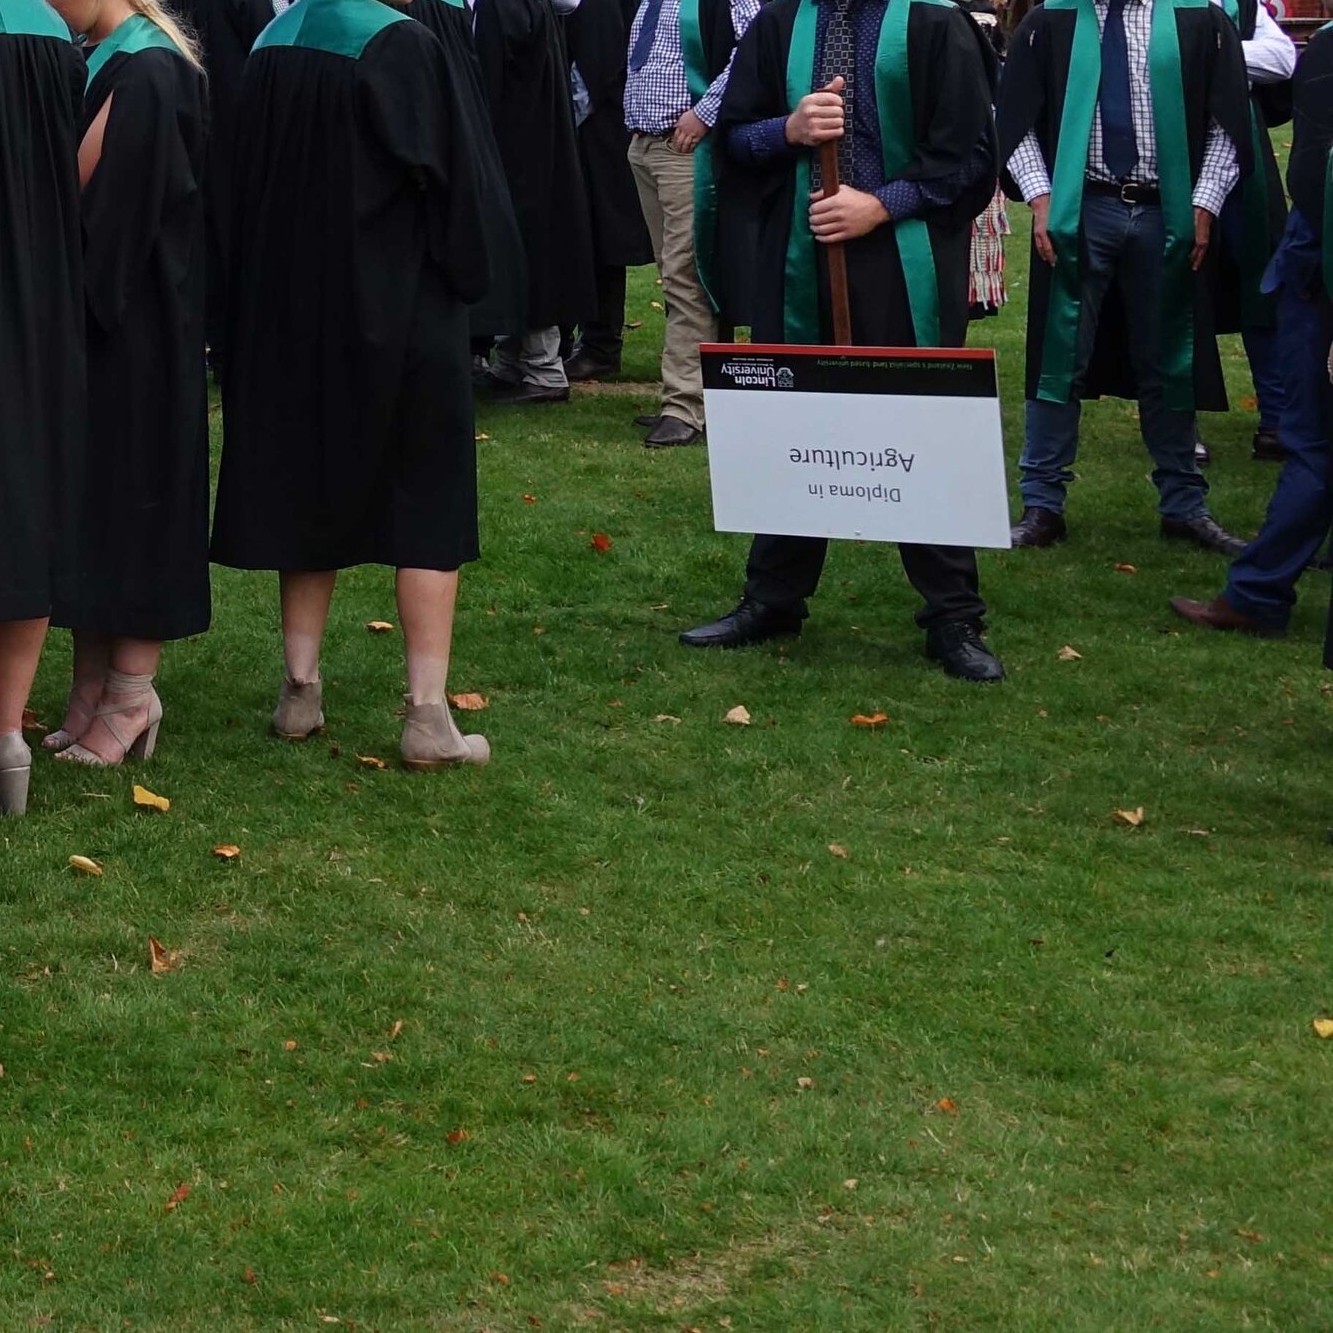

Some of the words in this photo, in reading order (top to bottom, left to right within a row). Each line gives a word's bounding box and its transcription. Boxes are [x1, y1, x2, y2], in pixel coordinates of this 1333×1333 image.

[720, 363, 775, 377] University
[734, 375, 776, 387] Lincoln
[789, 448, 915, 473] Agriculture
[808, 483, 824, 499] in
[829, 483, 902, 503] Diploma
